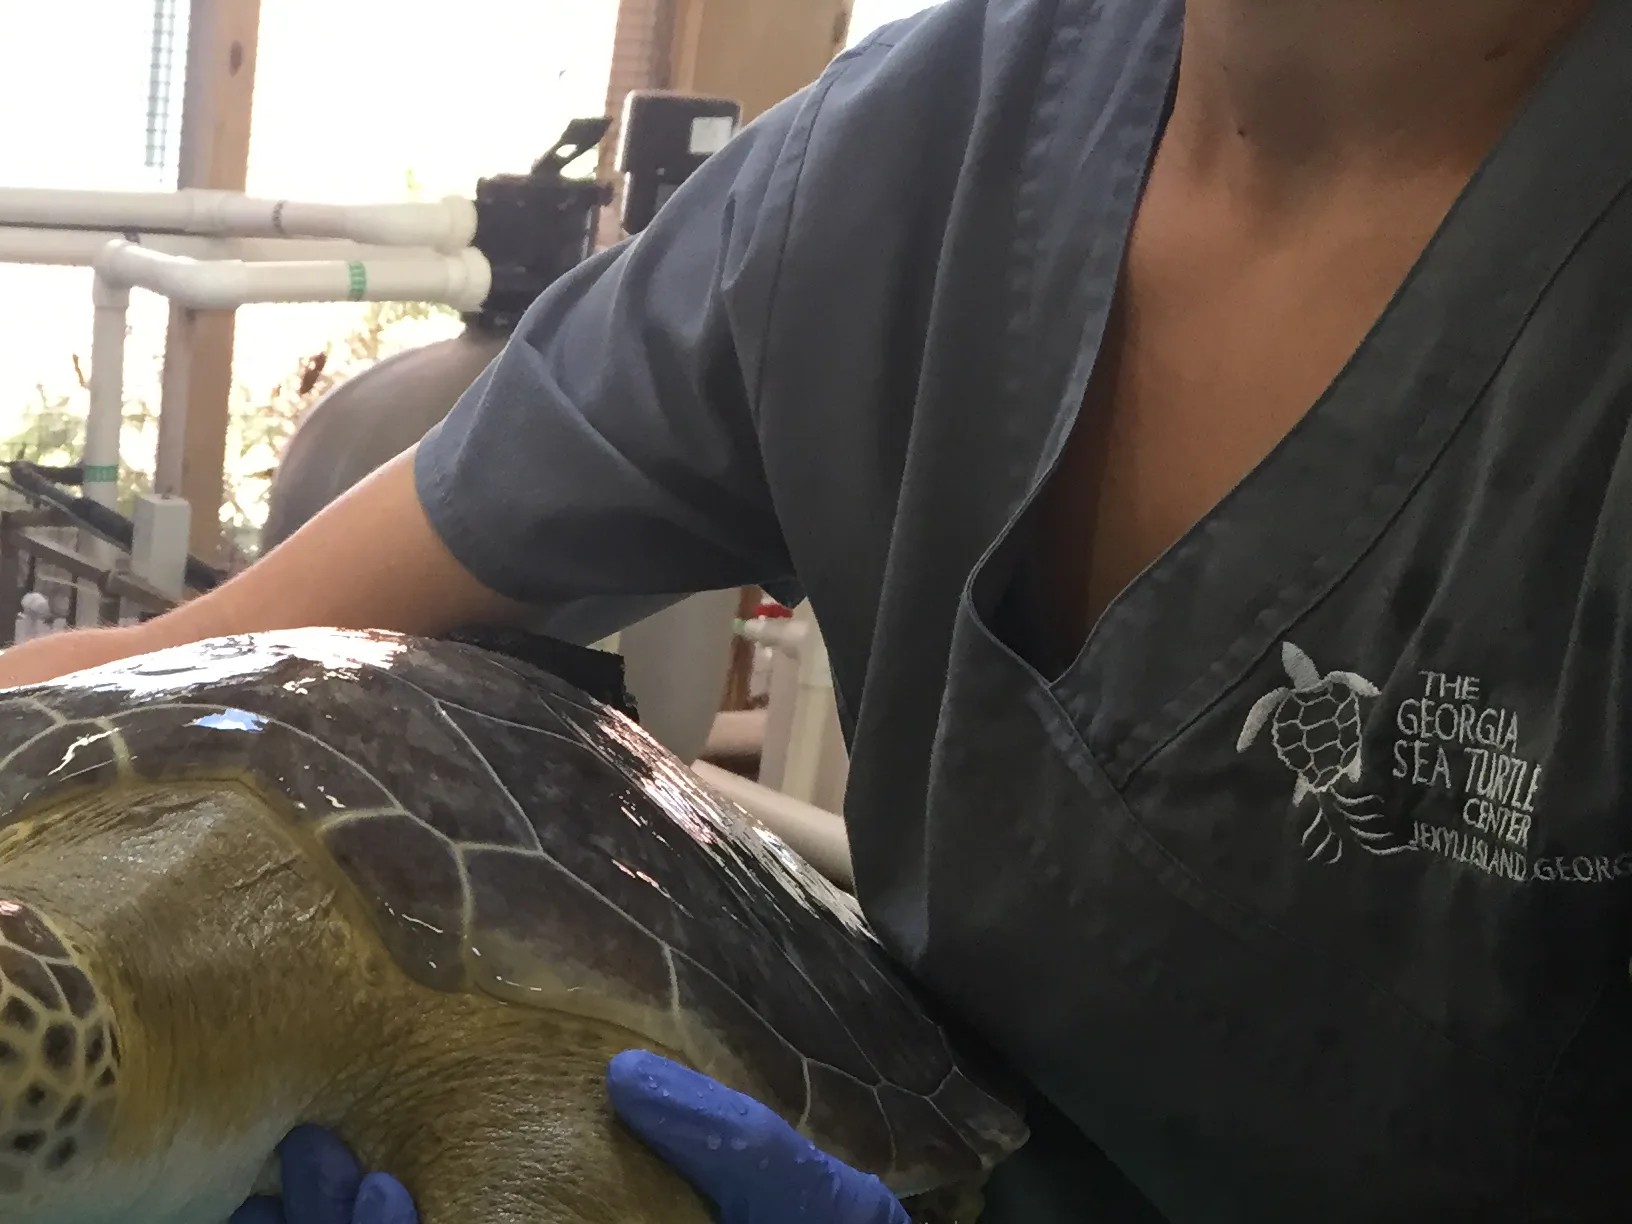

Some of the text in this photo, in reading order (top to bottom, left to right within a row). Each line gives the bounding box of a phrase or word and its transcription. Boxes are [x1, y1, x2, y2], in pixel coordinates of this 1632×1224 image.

[1419, 671, 1481, 700] THE
[1397, 698, 1519, 753] GEORGIA
[1392, 739, 1543, 812] SEA TURTLE
[1463, 798, 1532, 849] CENTER
[1469, 836, 1528, 882] ISLAND
